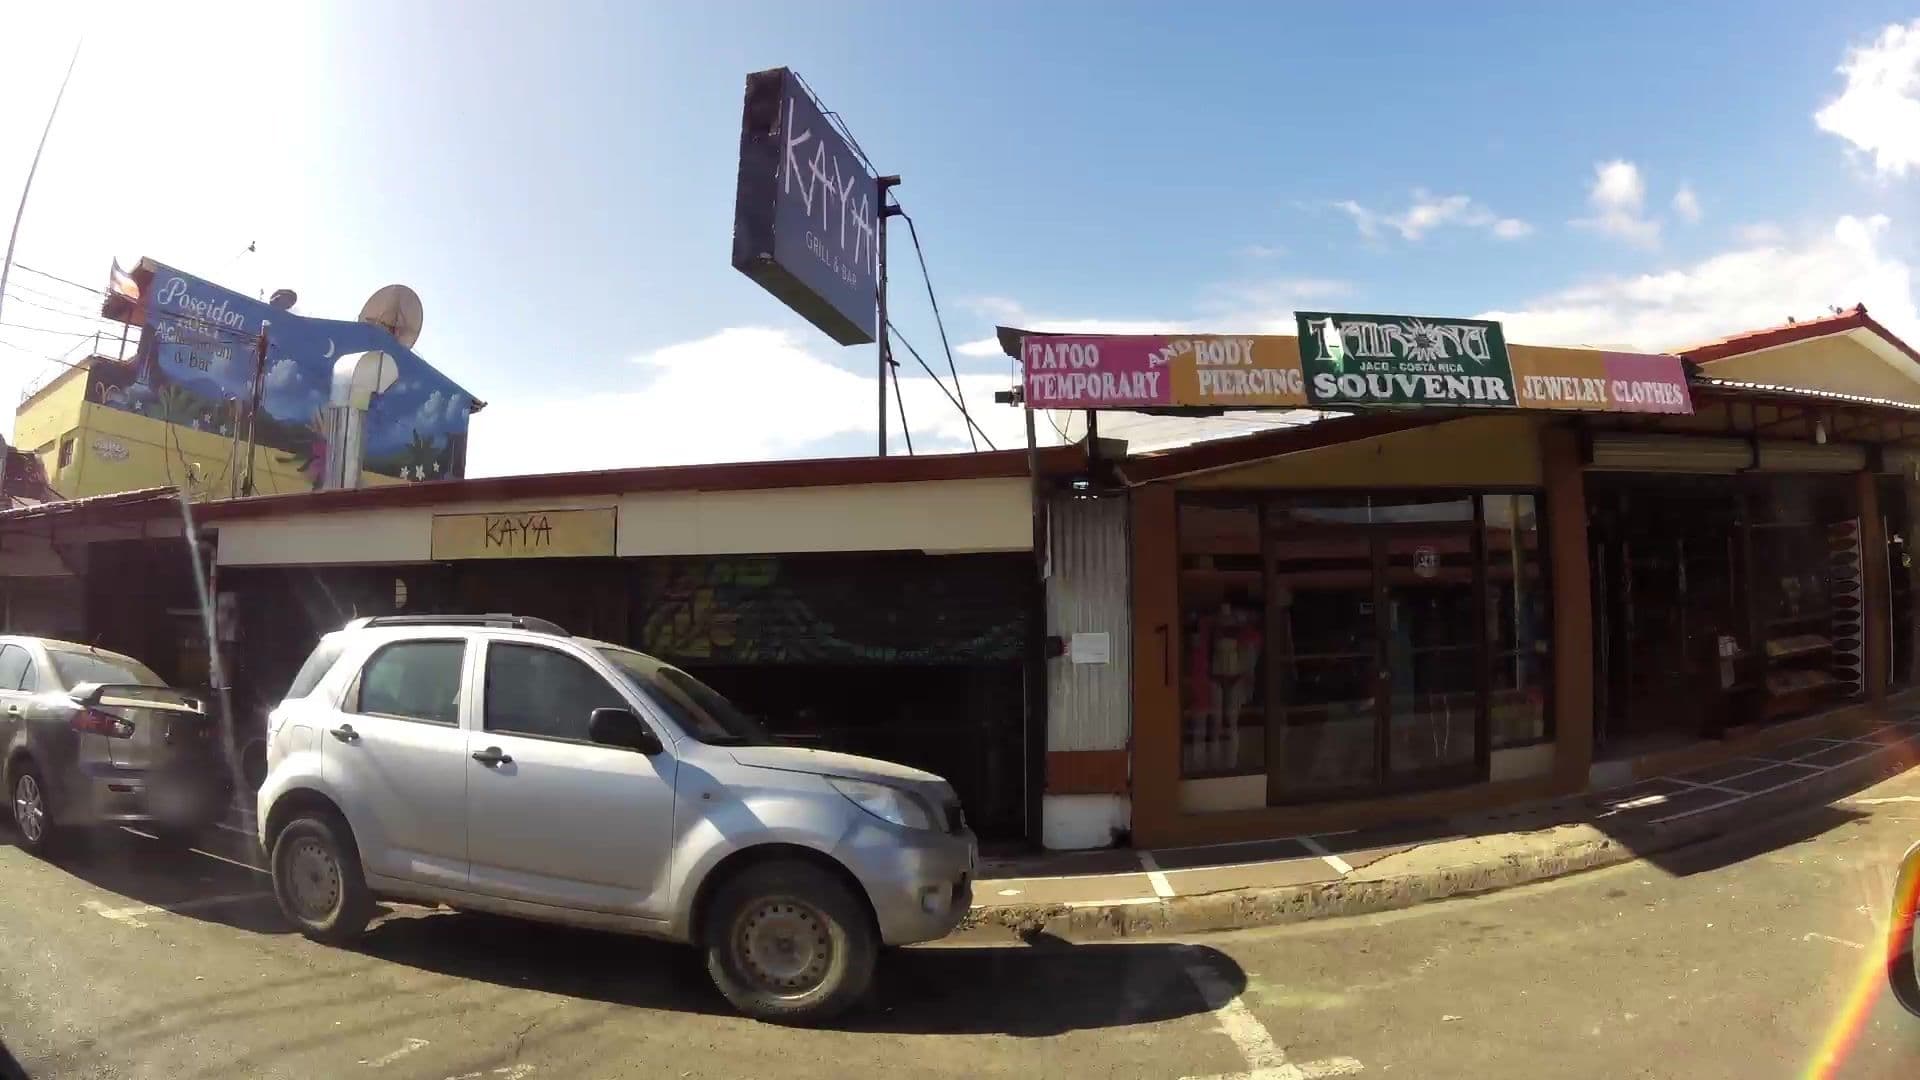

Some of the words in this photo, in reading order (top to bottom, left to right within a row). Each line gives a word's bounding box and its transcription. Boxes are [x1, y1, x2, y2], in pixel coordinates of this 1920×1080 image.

[784, 97, 873, 276] KAYA
[805, 230, 831, 266] GRILL
[832, 255, 840, 273] &
[841, 263, 857, 291] BAR
[157, 276, 246, 330] Poseidon
[1029, 343, 1100, 370] TATOO
[1148, 339, 1193, 369] AND
[1195, 340, 1255, 366] BODY
[1197, 369, 1304, 396] PIERCING
[1399, 362, 1435, 373] COSTA
[1439, 362, 1465, 374] RICA
[1029, 371, 1161, 400] TEMPORARY
[1312, 372, 1510, 401] SOUVENIR
[1522, 375, 1609, 403] JEWELRY
[1611, 379, 1684, 407] CLOTHES
[484, 516, 553, 548] KAYA
